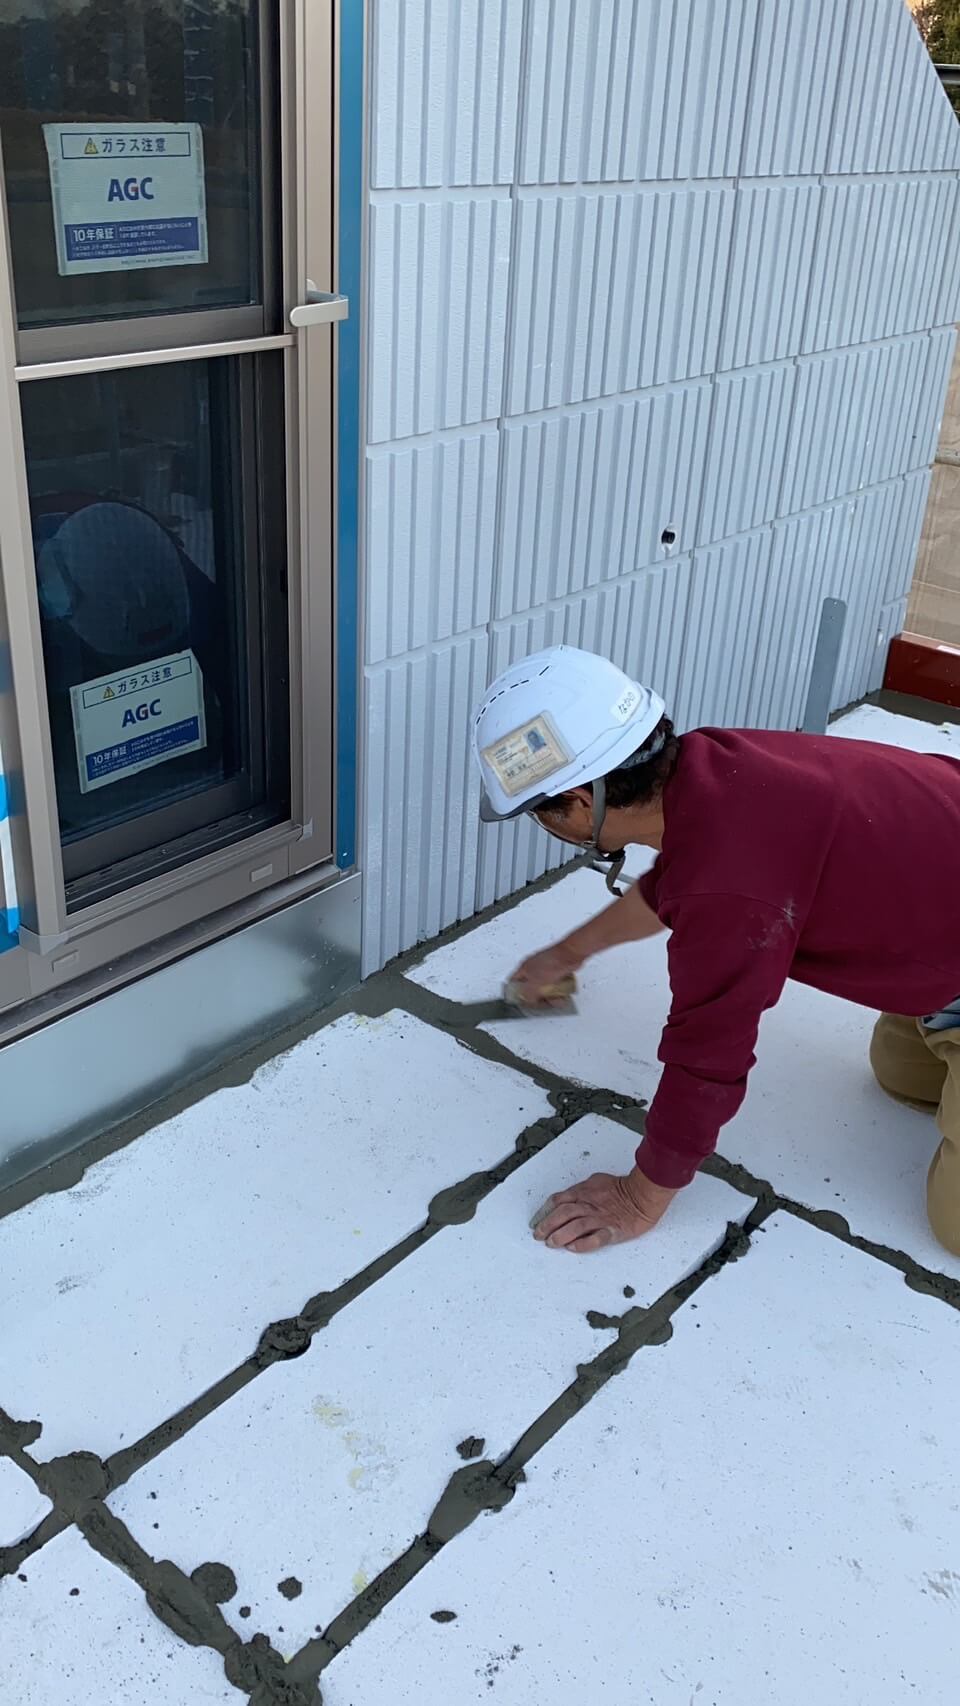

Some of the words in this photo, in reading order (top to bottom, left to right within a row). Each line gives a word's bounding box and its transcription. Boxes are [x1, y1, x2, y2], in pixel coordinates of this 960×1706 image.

[101, 137, 166, 153] ガラス注意
[107, 177, 154, 202] AGC
[73, 227, 114, 242] 10年保証
[118, 667, 172, 693] ガラス注意
[122, 698, 162, 728] AGC
